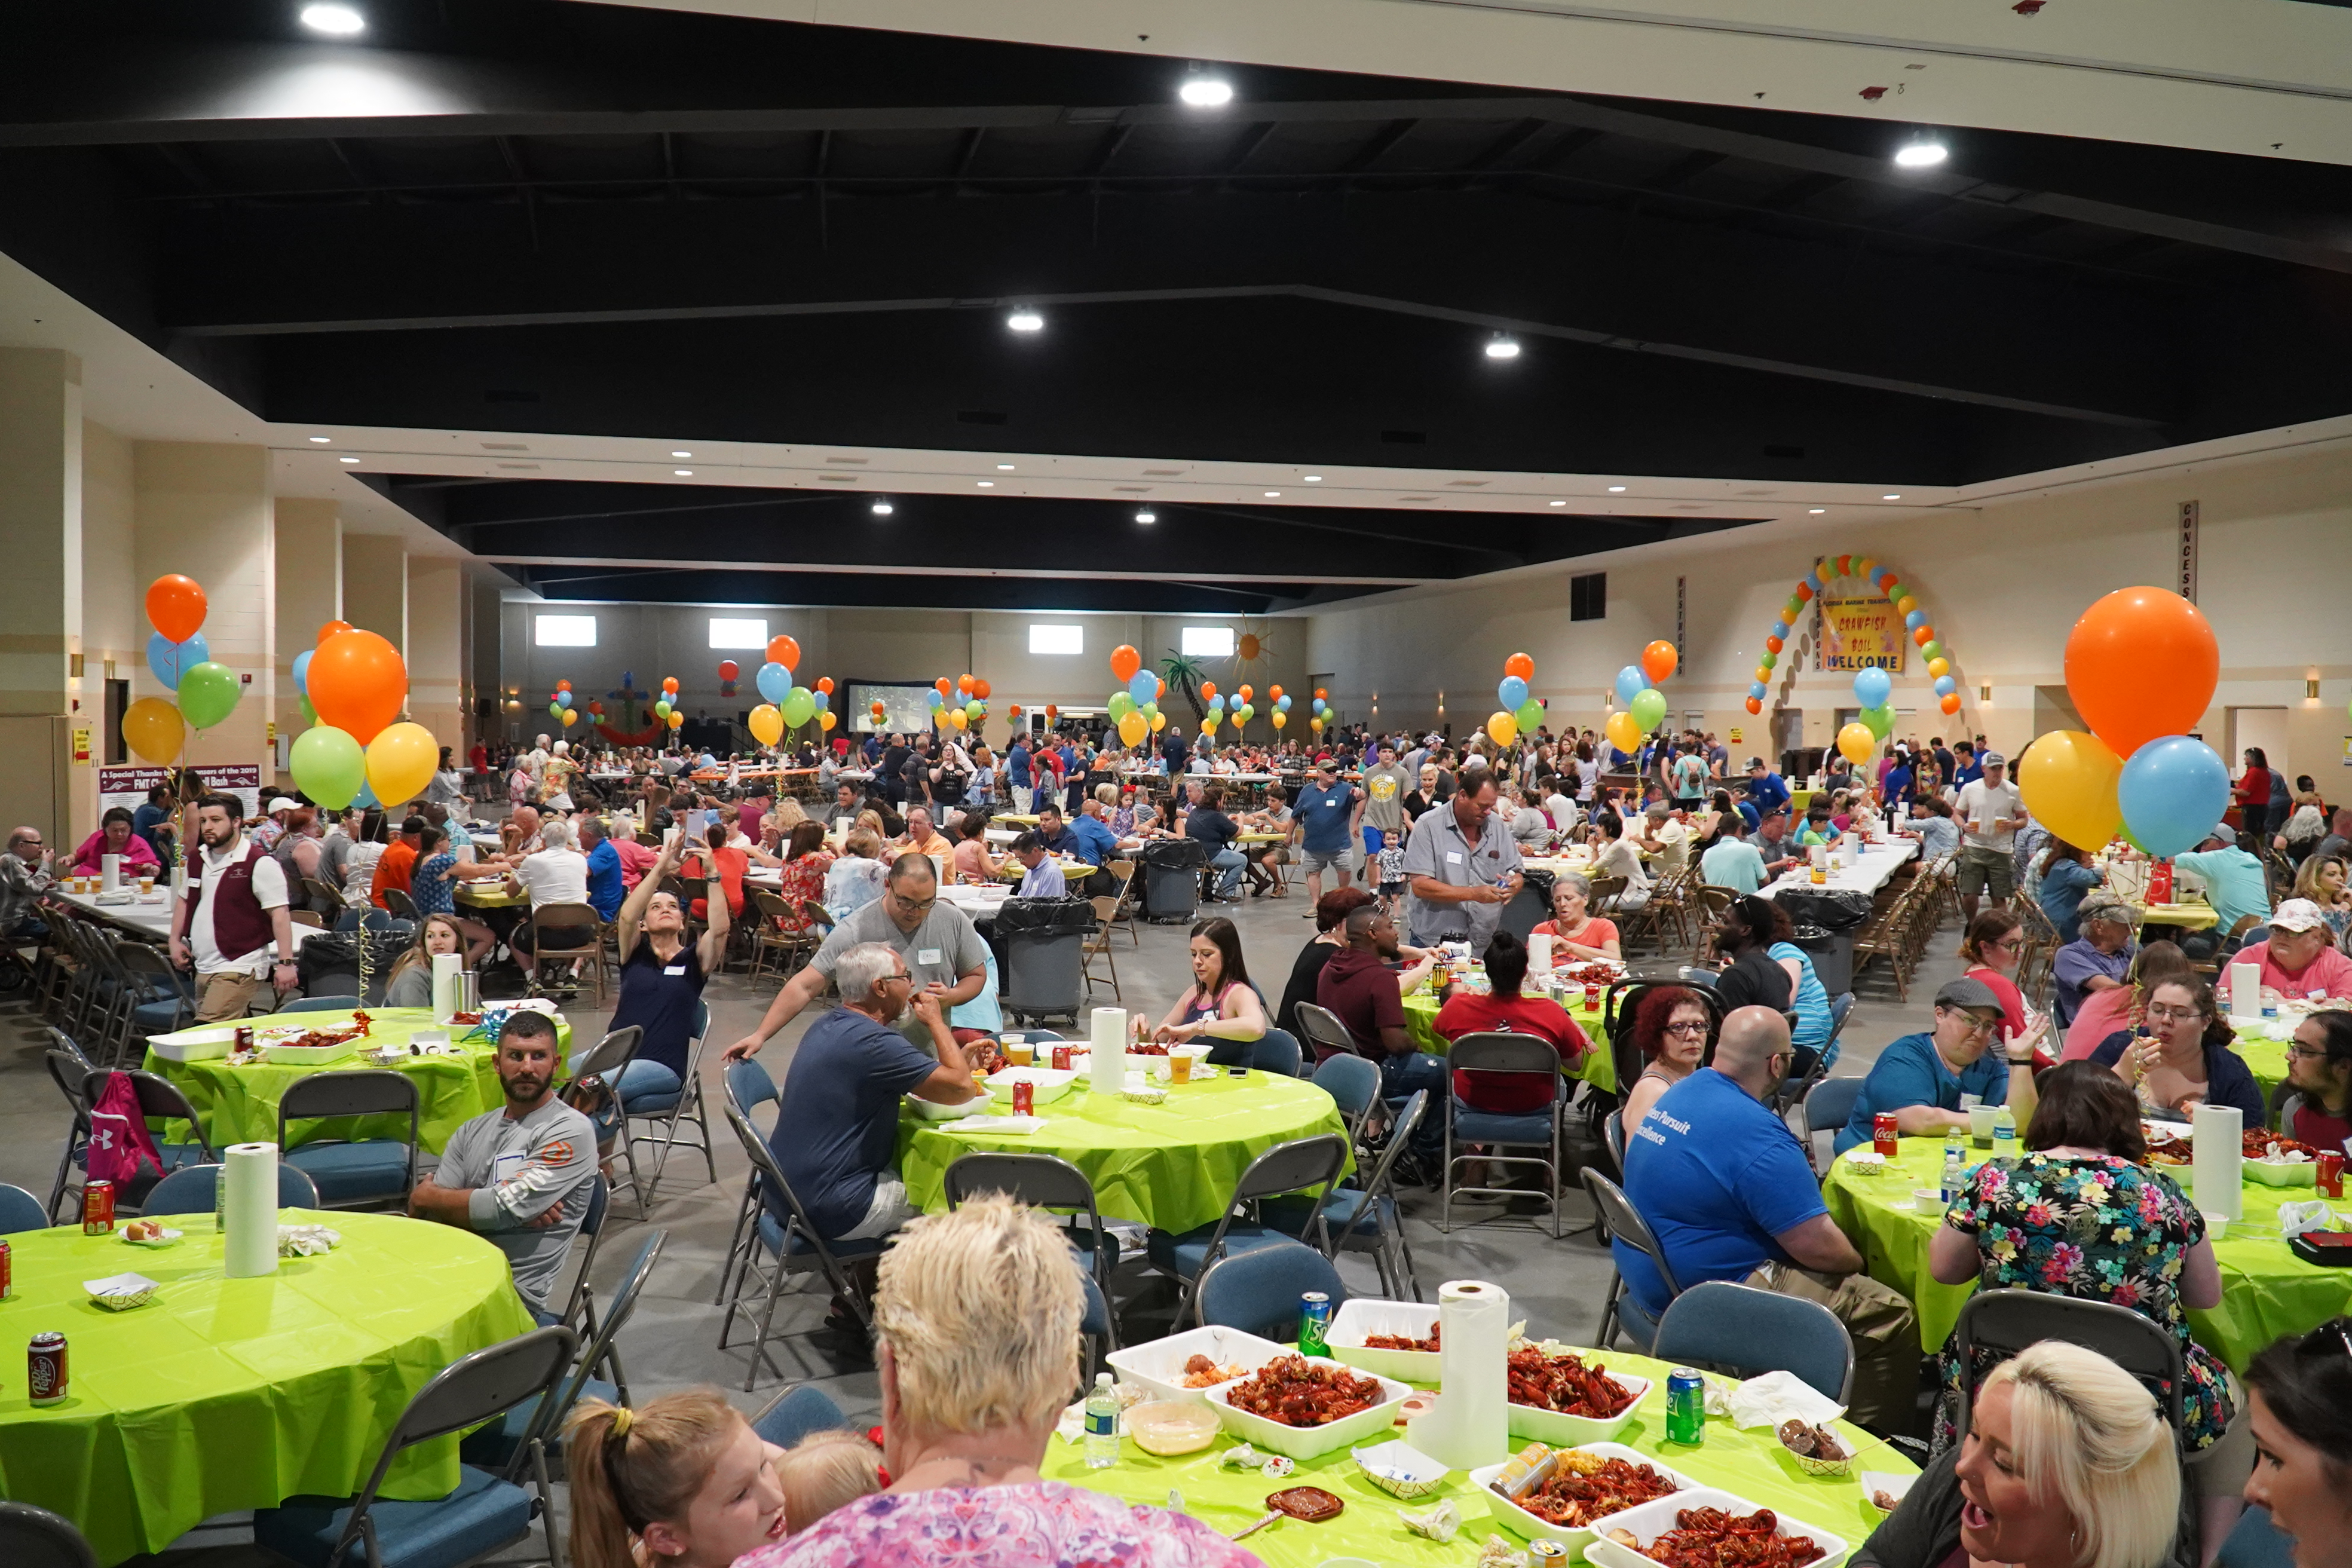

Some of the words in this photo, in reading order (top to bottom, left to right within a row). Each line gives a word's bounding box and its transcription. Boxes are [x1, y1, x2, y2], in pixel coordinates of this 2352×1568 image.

[2182, 504, 2191, 598] CONCESS
[1839, 615, 1886, 631] CRAWFISH
[1851, 638, 1872, 653] BOIL
[1827, 655, 1898, 669] WELCOME
[109, 770, 134, 779] Special
[133, 778, 150, 789] FMT
[210, 776, 228, 787] Bash
[1658, 1110, 1691, 1136] Pursuit
[32, 1359, 52, 1392] Pepper
